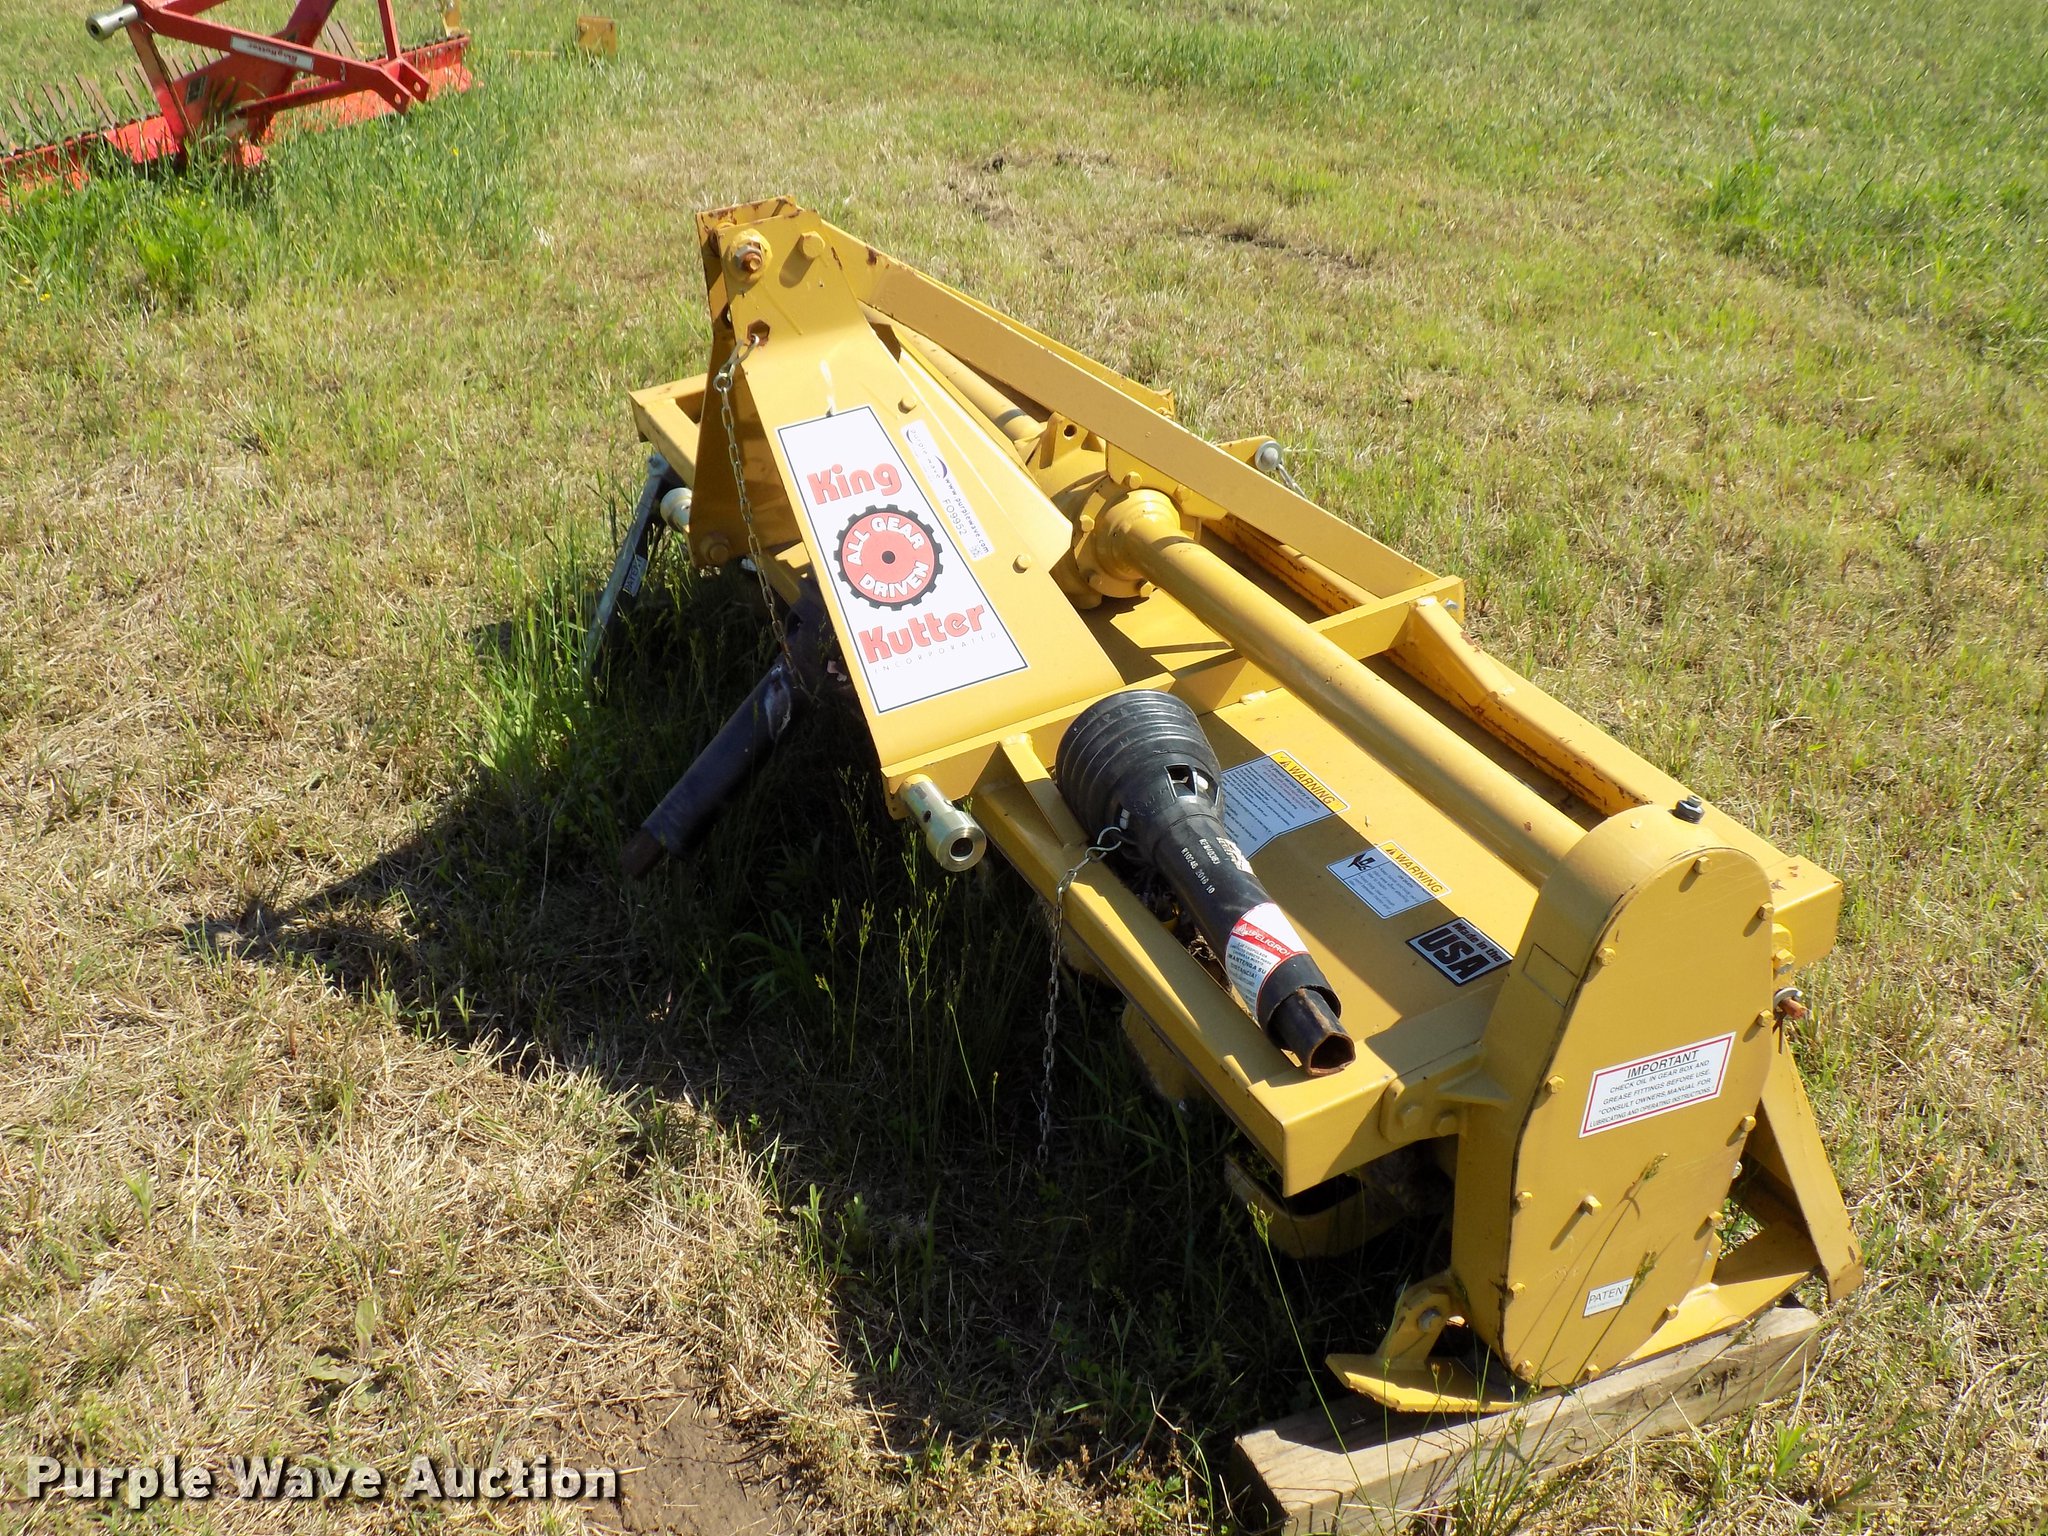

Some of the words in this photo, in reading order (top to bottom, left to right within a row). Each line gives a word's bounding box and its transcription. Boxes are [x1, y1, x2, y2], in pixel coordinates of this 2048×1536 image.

[807, 463, 902, 505] King
[945, 478, 990, 554] www.purplewave.com
[846, 529, 872, 567] ALL
[870, 516, 925, 550] GEAR
[858, 560, 930, 598] DRIVEN
[858, 604, 985, 664] Kutter
[1289, 766, 1335, 805] WARNING
[1206, 883, 1216, 895] 10
[1395, 853, 1443, 893] WARNING
[1417, 928, 1492, 981] USA
[1452, 922, 1479, 943] Made
[1476, 941, 1488, 950] in
[1485, 947, 1504, 963] the
[1609, 1081, 1635, 1094] CHECK
[1635, 1077, 1648, 1087] OIL
[1648, 1074, 1657, 1083] IN
[1657, 1068, 1678, 1080] GEAR
[1679, 1063, 1694, 1074] BOX
[1694, 1060, 1710, 1070] AND
[1627, 1050, 1700, 1079] IMPORTANT
[1603, 1092, 1633, 1105] GREASE
[1633, 1082, 1665, 1097] FITTINGS
[1666, 1074, 1695, 1087] BEFORE
[1667, 1084, 1696, 1098] MANUAL
[1696, 1077, 1712, 1087] FOR
[1589, 1111, 1627, 1128] LUBRICATING
[1627, 1107, 1640, 1116] AND
[1639, 1098, 1671, 1113] OPERATING
[1588, 1284, 1631, 1305] PATENT
